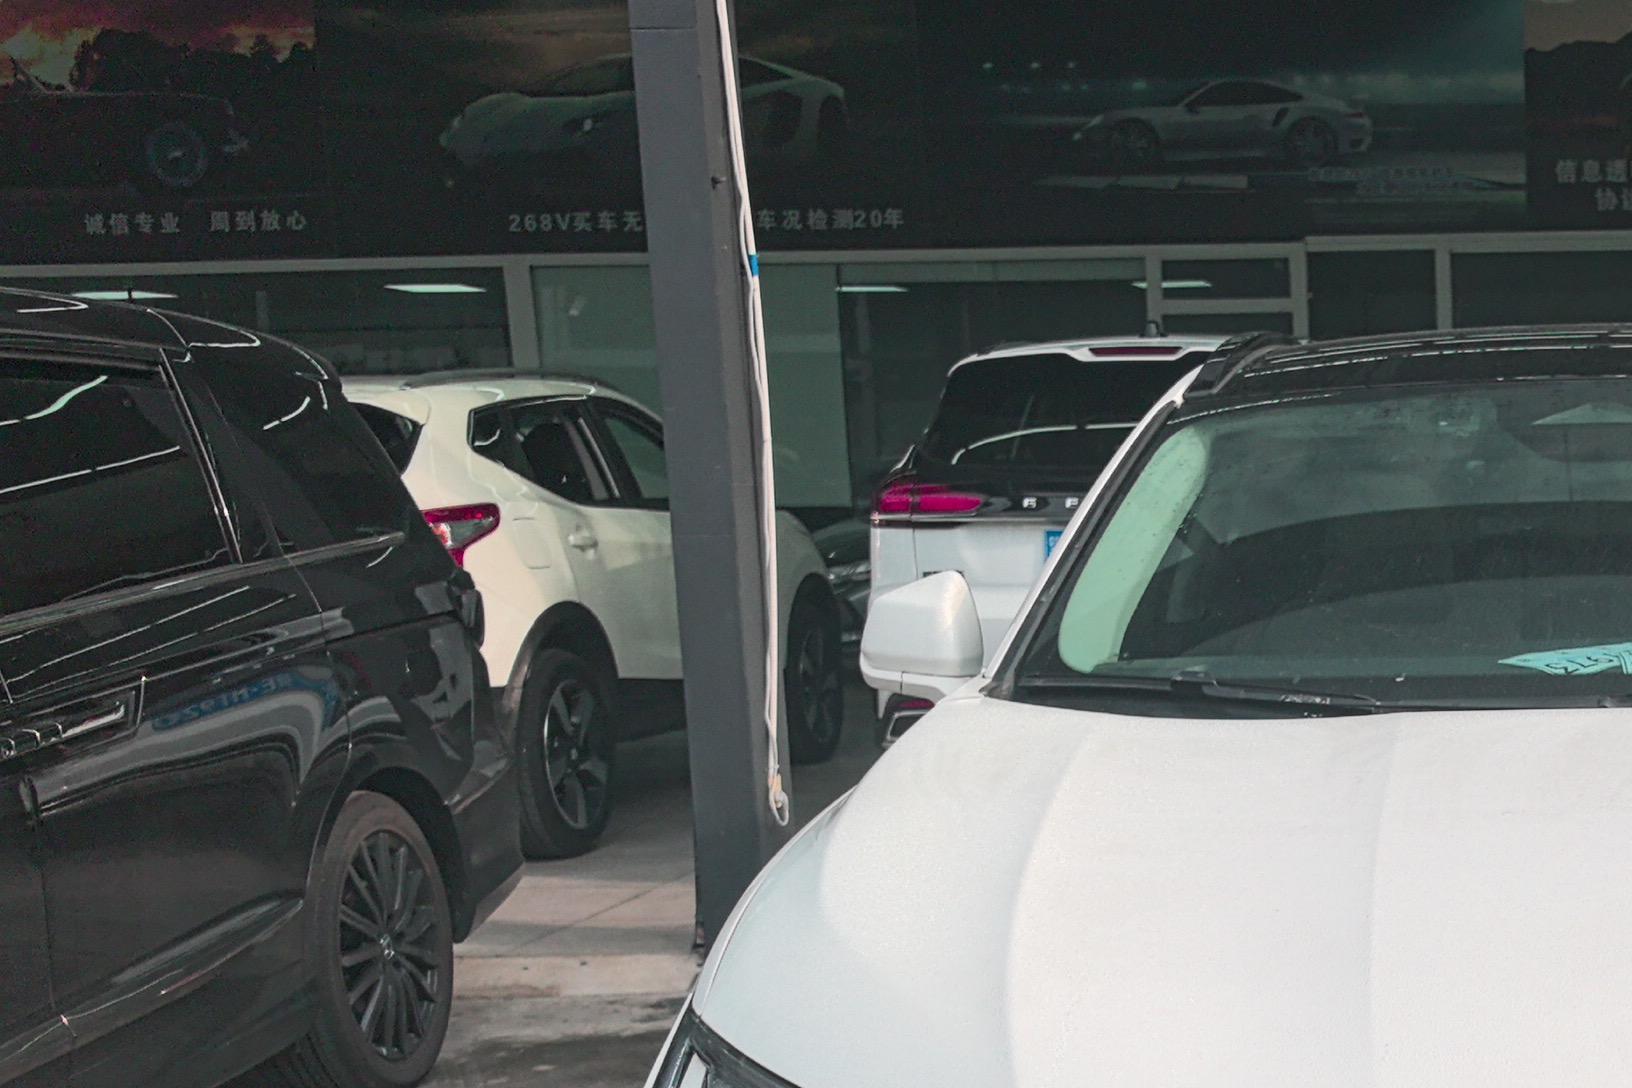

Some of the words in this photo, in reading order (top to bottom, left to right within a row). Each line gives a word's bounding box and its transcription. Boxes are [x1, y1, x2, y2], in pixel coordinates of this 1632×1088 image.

[83, 210, 180, 235] 诚信专业
[210, 208, 308, 233] 周到放心
